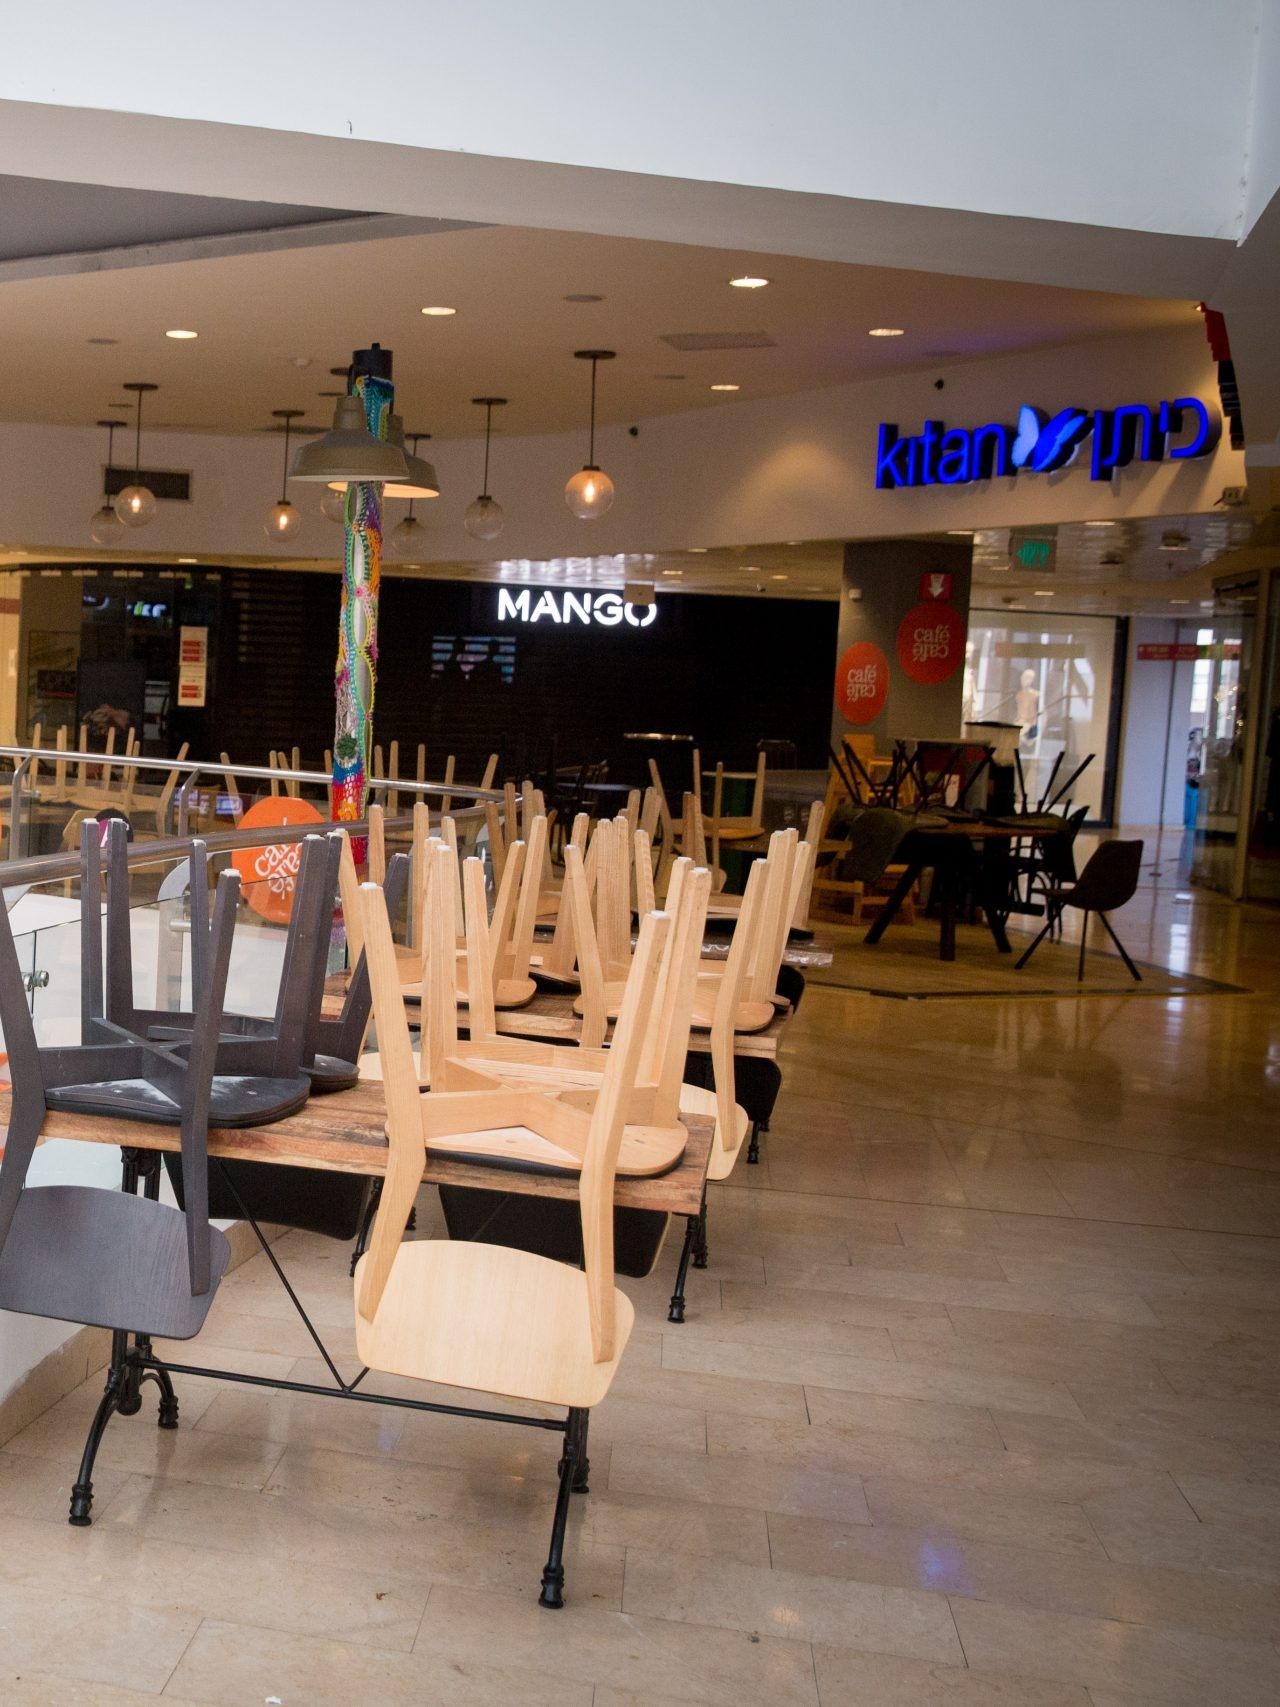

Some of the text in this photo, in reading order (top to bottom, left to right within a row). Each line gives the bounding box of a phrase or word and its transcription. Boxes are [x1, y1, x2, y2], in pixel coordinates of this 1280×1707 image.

[1091, 397, 1211, 482] כיתן
[497, 588, 658, 627] MANGO
[913, 624, 950, 643] café
[847, 664, 877, 683] café
